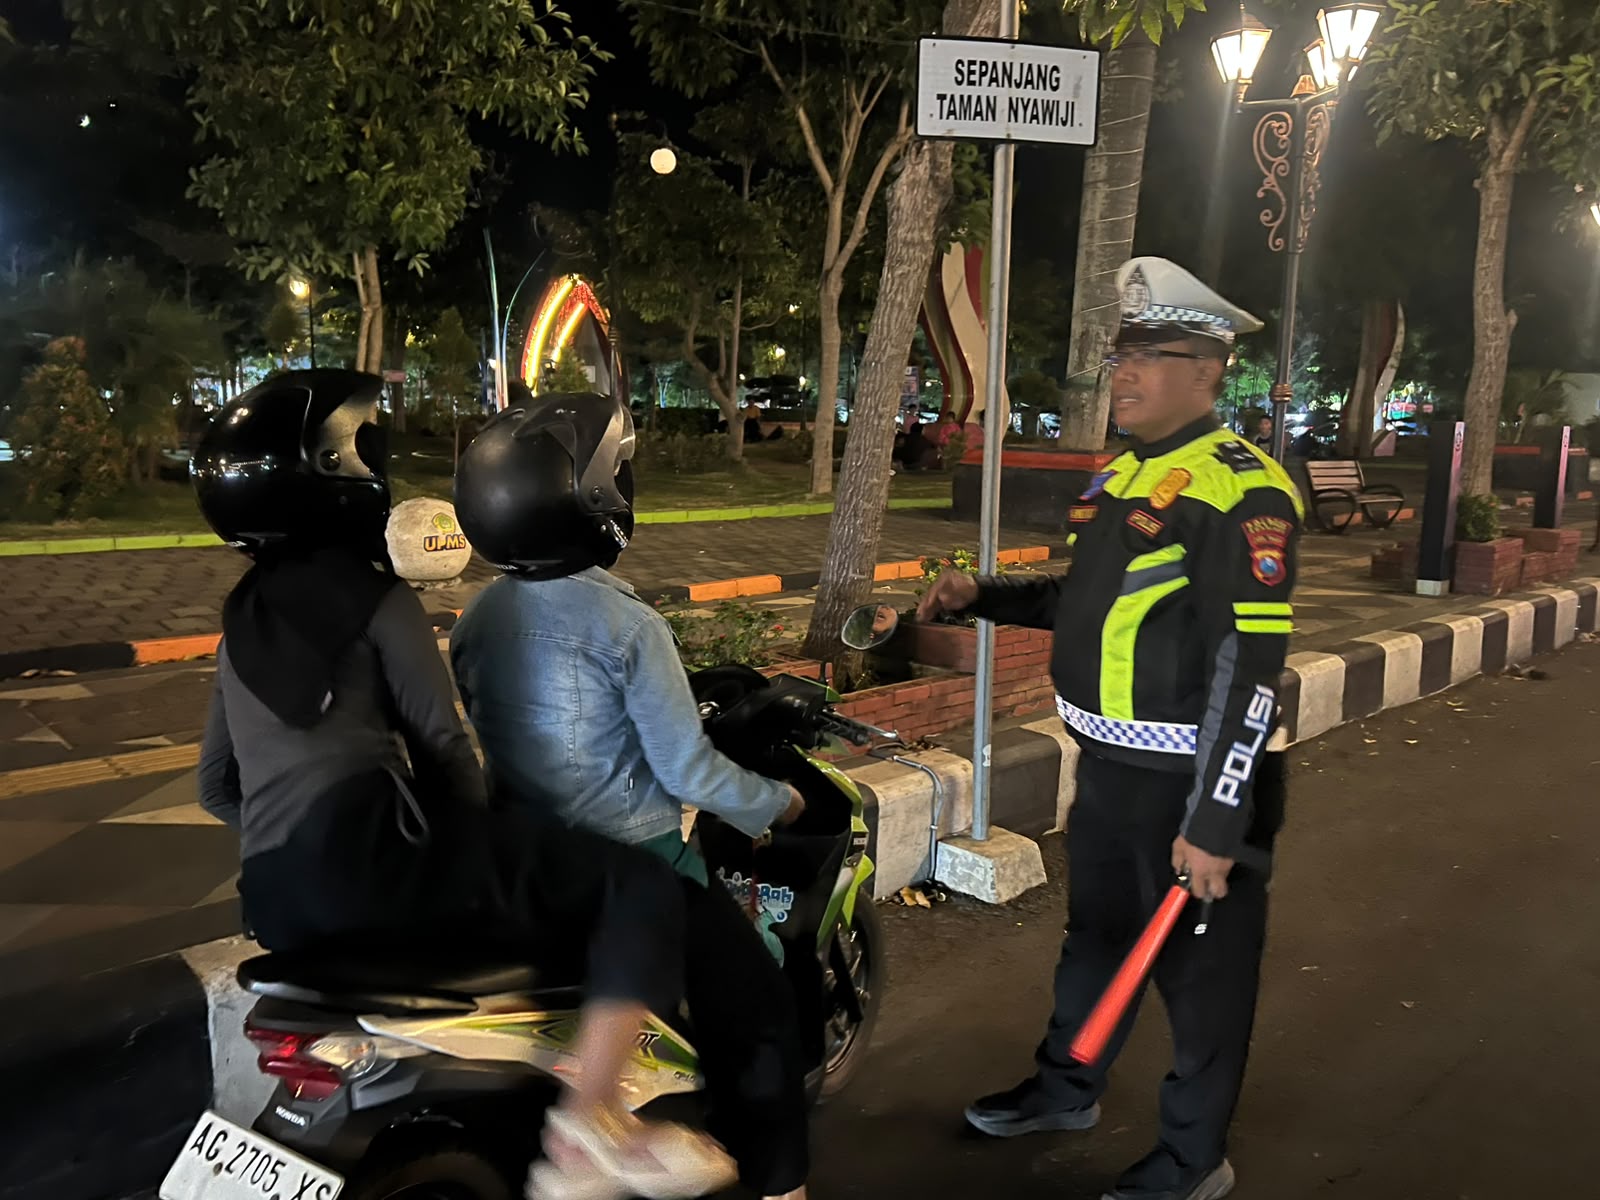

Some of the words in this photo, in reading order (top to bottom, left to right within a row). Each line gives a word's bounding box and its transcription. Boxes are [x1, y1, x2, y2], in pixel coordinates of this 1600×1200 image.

[954, 58, 1061, 92] SEPANJANG
[936, 93, 997, 122] TAMAN
[1007, 97, 1075, 127] NYAWIJI
[423, 533, 467, 552] UPMS
[1211, 683, 1276, 808] POLISI
[275, 1105, 306, 1127] HONDA
[189, 1121, 228, 1162] AG
[223, 1141, 286, 1192] 2705
